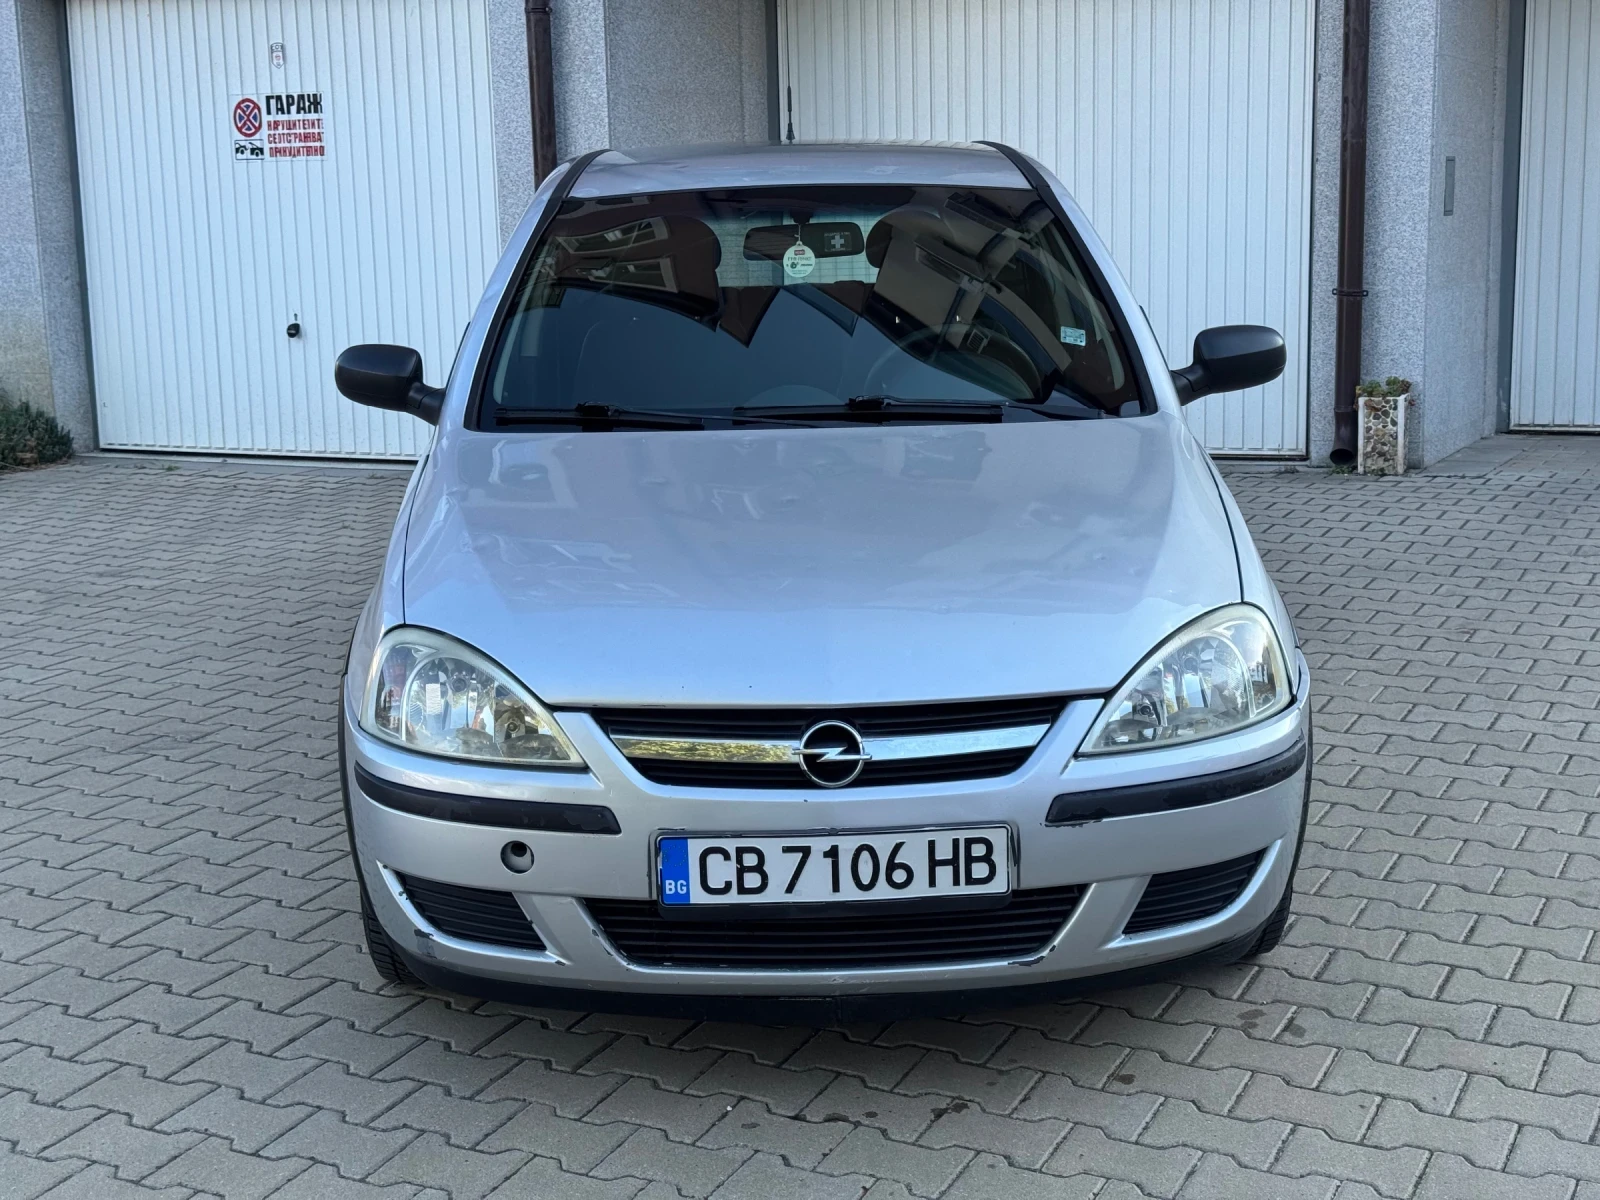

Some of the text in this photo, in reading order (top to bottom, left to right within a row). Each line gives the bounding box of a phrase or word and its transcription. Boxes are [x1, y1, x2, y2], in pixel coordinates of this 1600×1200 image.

[265, 93, 323, 115] ГАРАЖ
[699, 836, 997, 895] CB 7106 HB
[665, 880, 687, 895] BG
